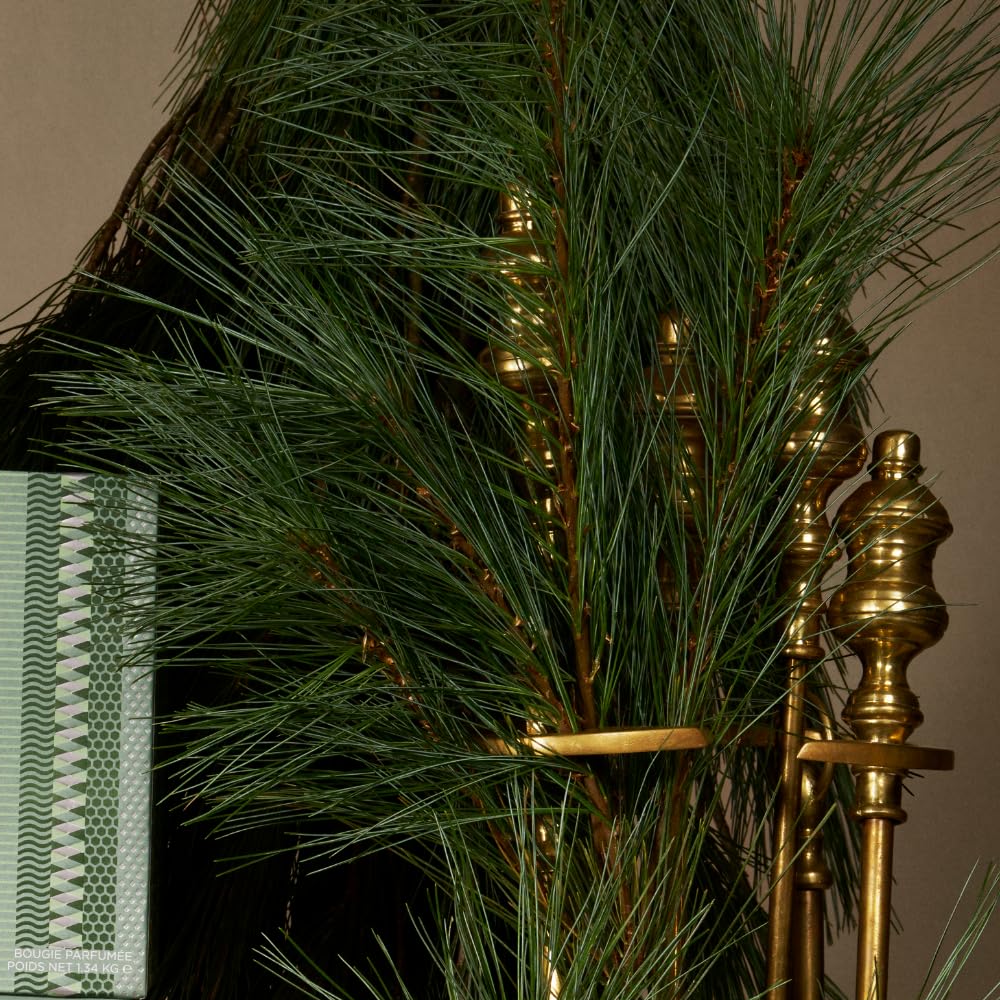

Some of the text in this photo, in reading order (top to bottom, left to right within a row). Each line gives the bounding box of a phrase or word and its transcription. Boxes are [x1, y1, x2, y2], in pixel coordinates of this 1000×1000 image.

[14, 948, 133, 961] BOUGIE PARFUMÉE
[7, 961, 45, 972] POIDS
[48, 962, 73, 973] NET
[102, 963, 119, 974] KG
